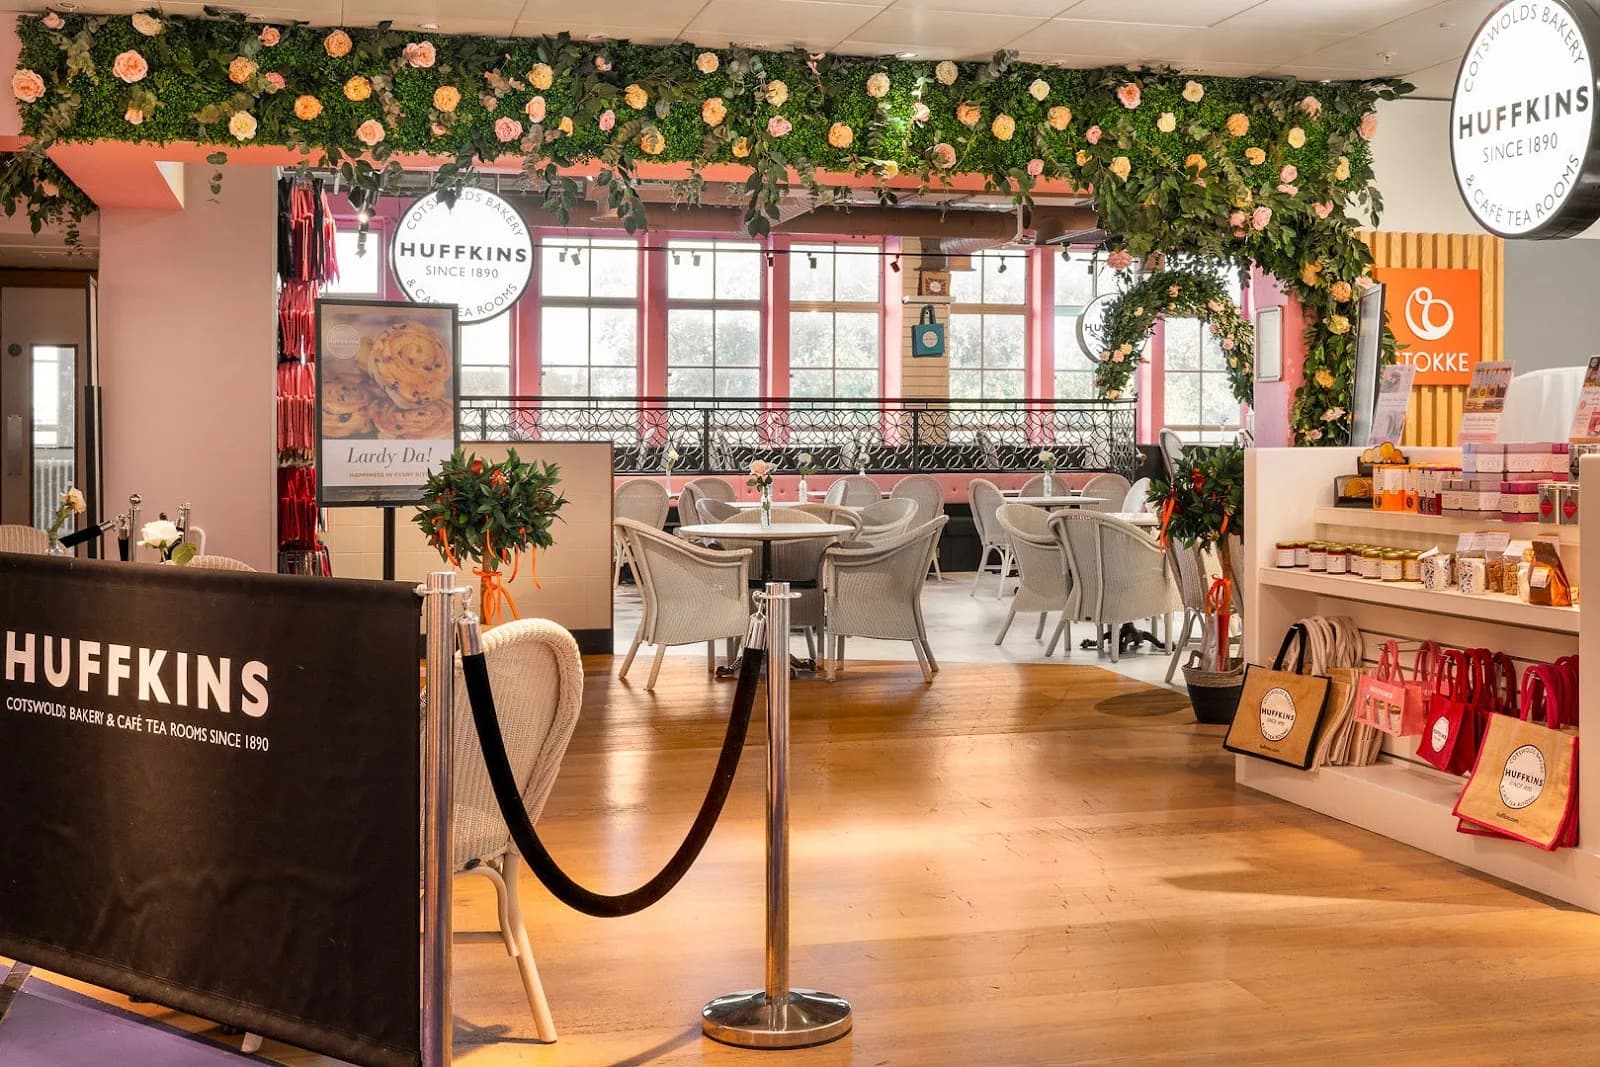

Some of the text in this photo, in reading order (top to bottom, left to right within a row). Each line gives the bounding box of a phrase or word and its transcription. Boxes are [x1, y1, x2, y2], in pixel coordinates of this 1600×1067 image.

[1464, 4, 1585, 92] COTSWOLDS BAKERY
[1459, 85, 1589, 140] HUFFKINS
[1482, 132, 1559, 163] SINCE 1890
[1465, 173, 1475, 187] &
[1508, 210, 1532, 227] TEA
[1536, 154, 1580, 219] ROOMS
[485, 197, 524, 237] BAKERY
[400, 242, 527, 262] HUFFKINS
[425, 265, 499, 279] SINCE 1890
[406, 279, 416, 288] &
[458, 307, 473, 317] EA
[477, 283, 518, 314] ROOMS
[347, 447, 433, 469] Lardy Da!
[5, 630, 269, 718] HUFFKINS
[6, 697, 269, 752] COTSWOLDS BAKERY & CAFÉ TEA ROOMS SINCE 1890
[1261, 707, 1295, 721] HUFFKINS
[1504, 767, 1544, 787] HUFFKINS
